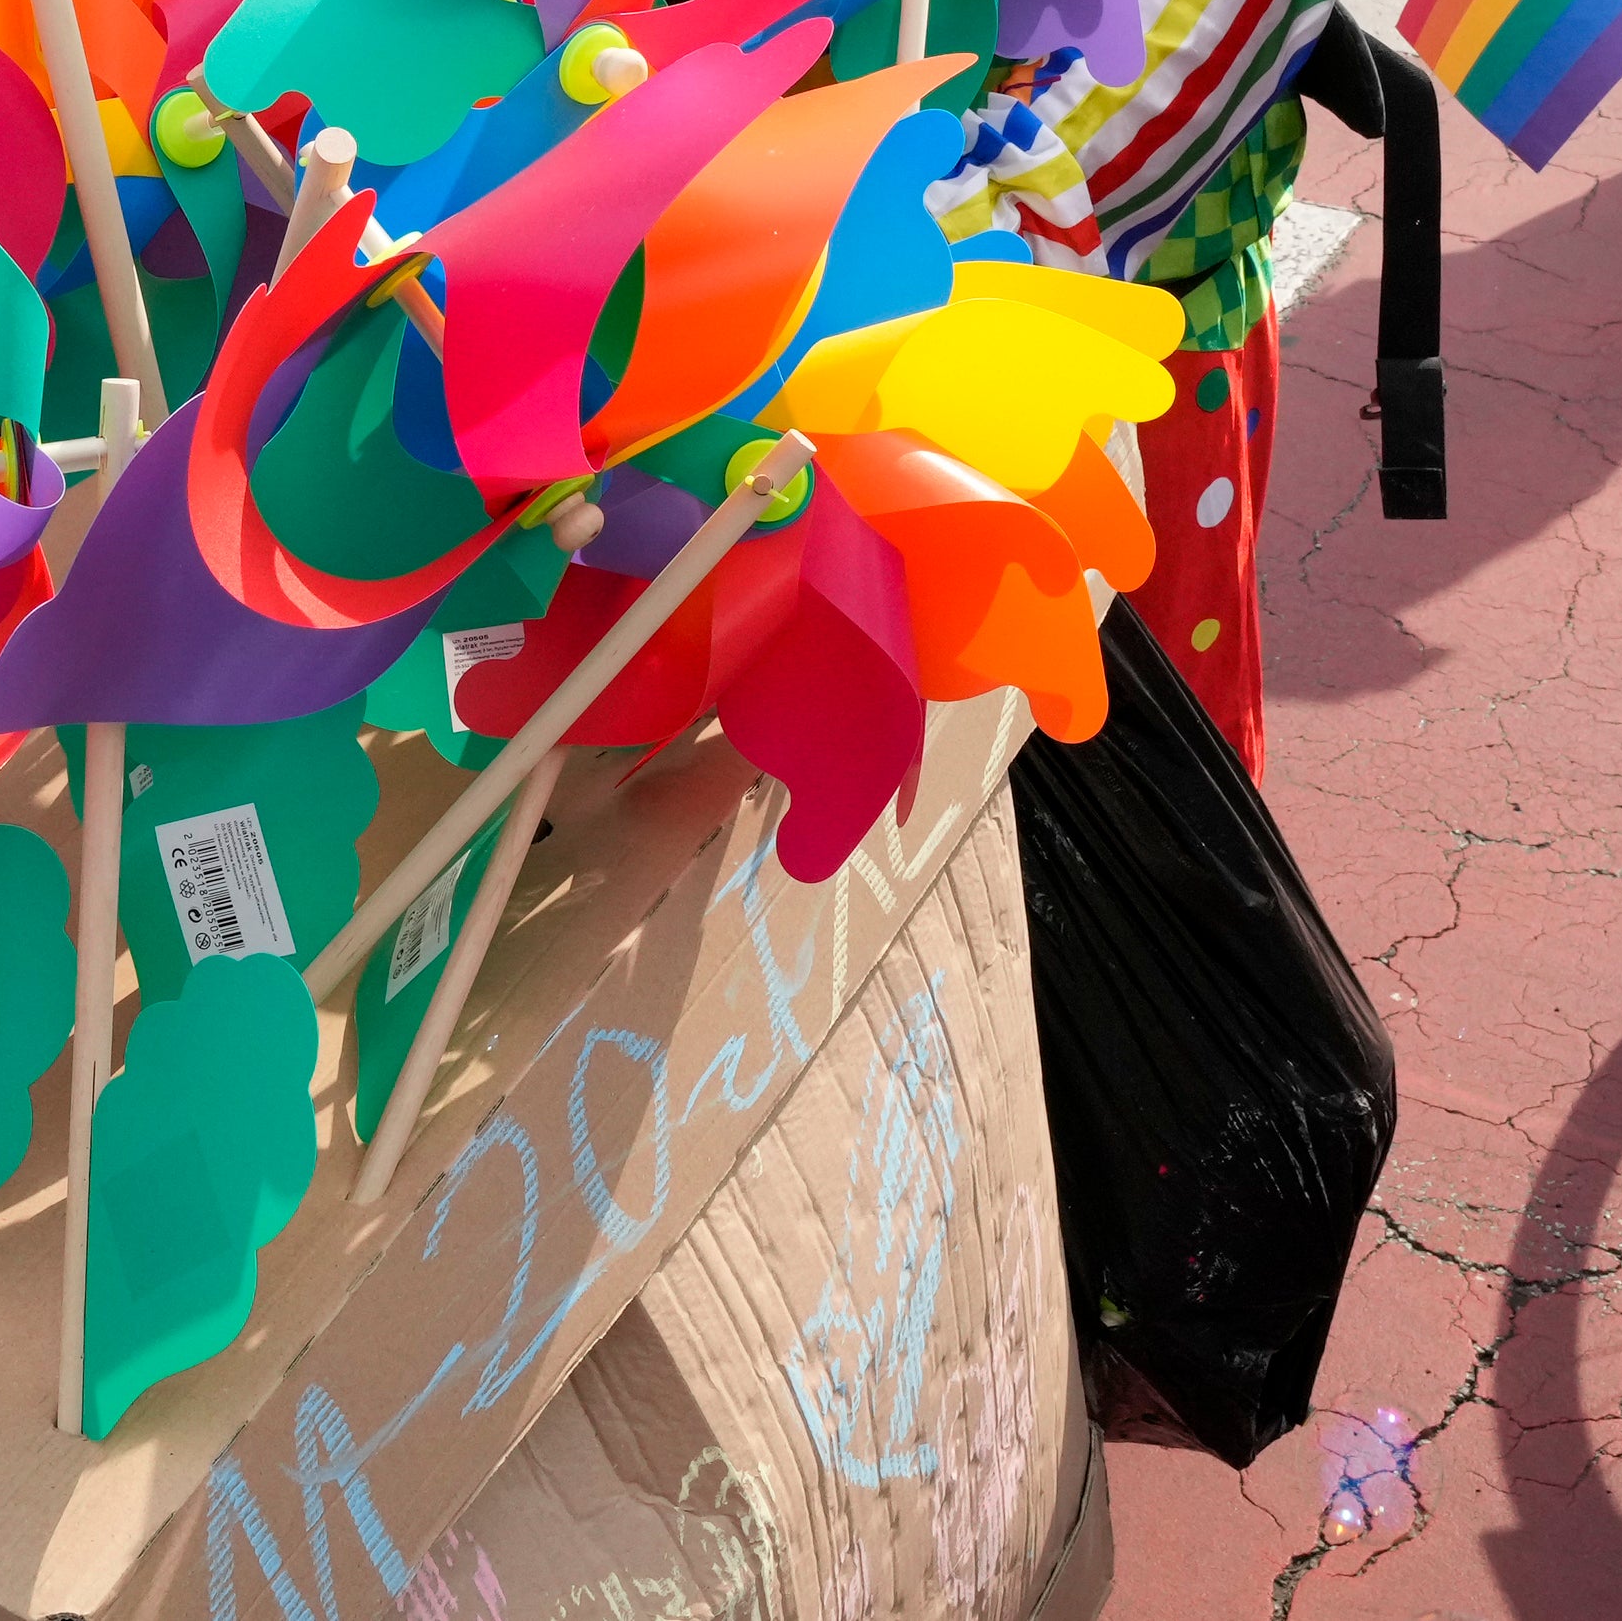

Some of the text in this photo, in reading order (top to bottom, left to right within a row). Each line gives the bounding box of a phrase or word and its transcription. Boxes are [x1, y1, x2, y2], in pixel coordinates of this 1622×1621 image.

[239, 820, 252, 852] wiatrak
[183, 832, 222, 948] 2 023518 205055
